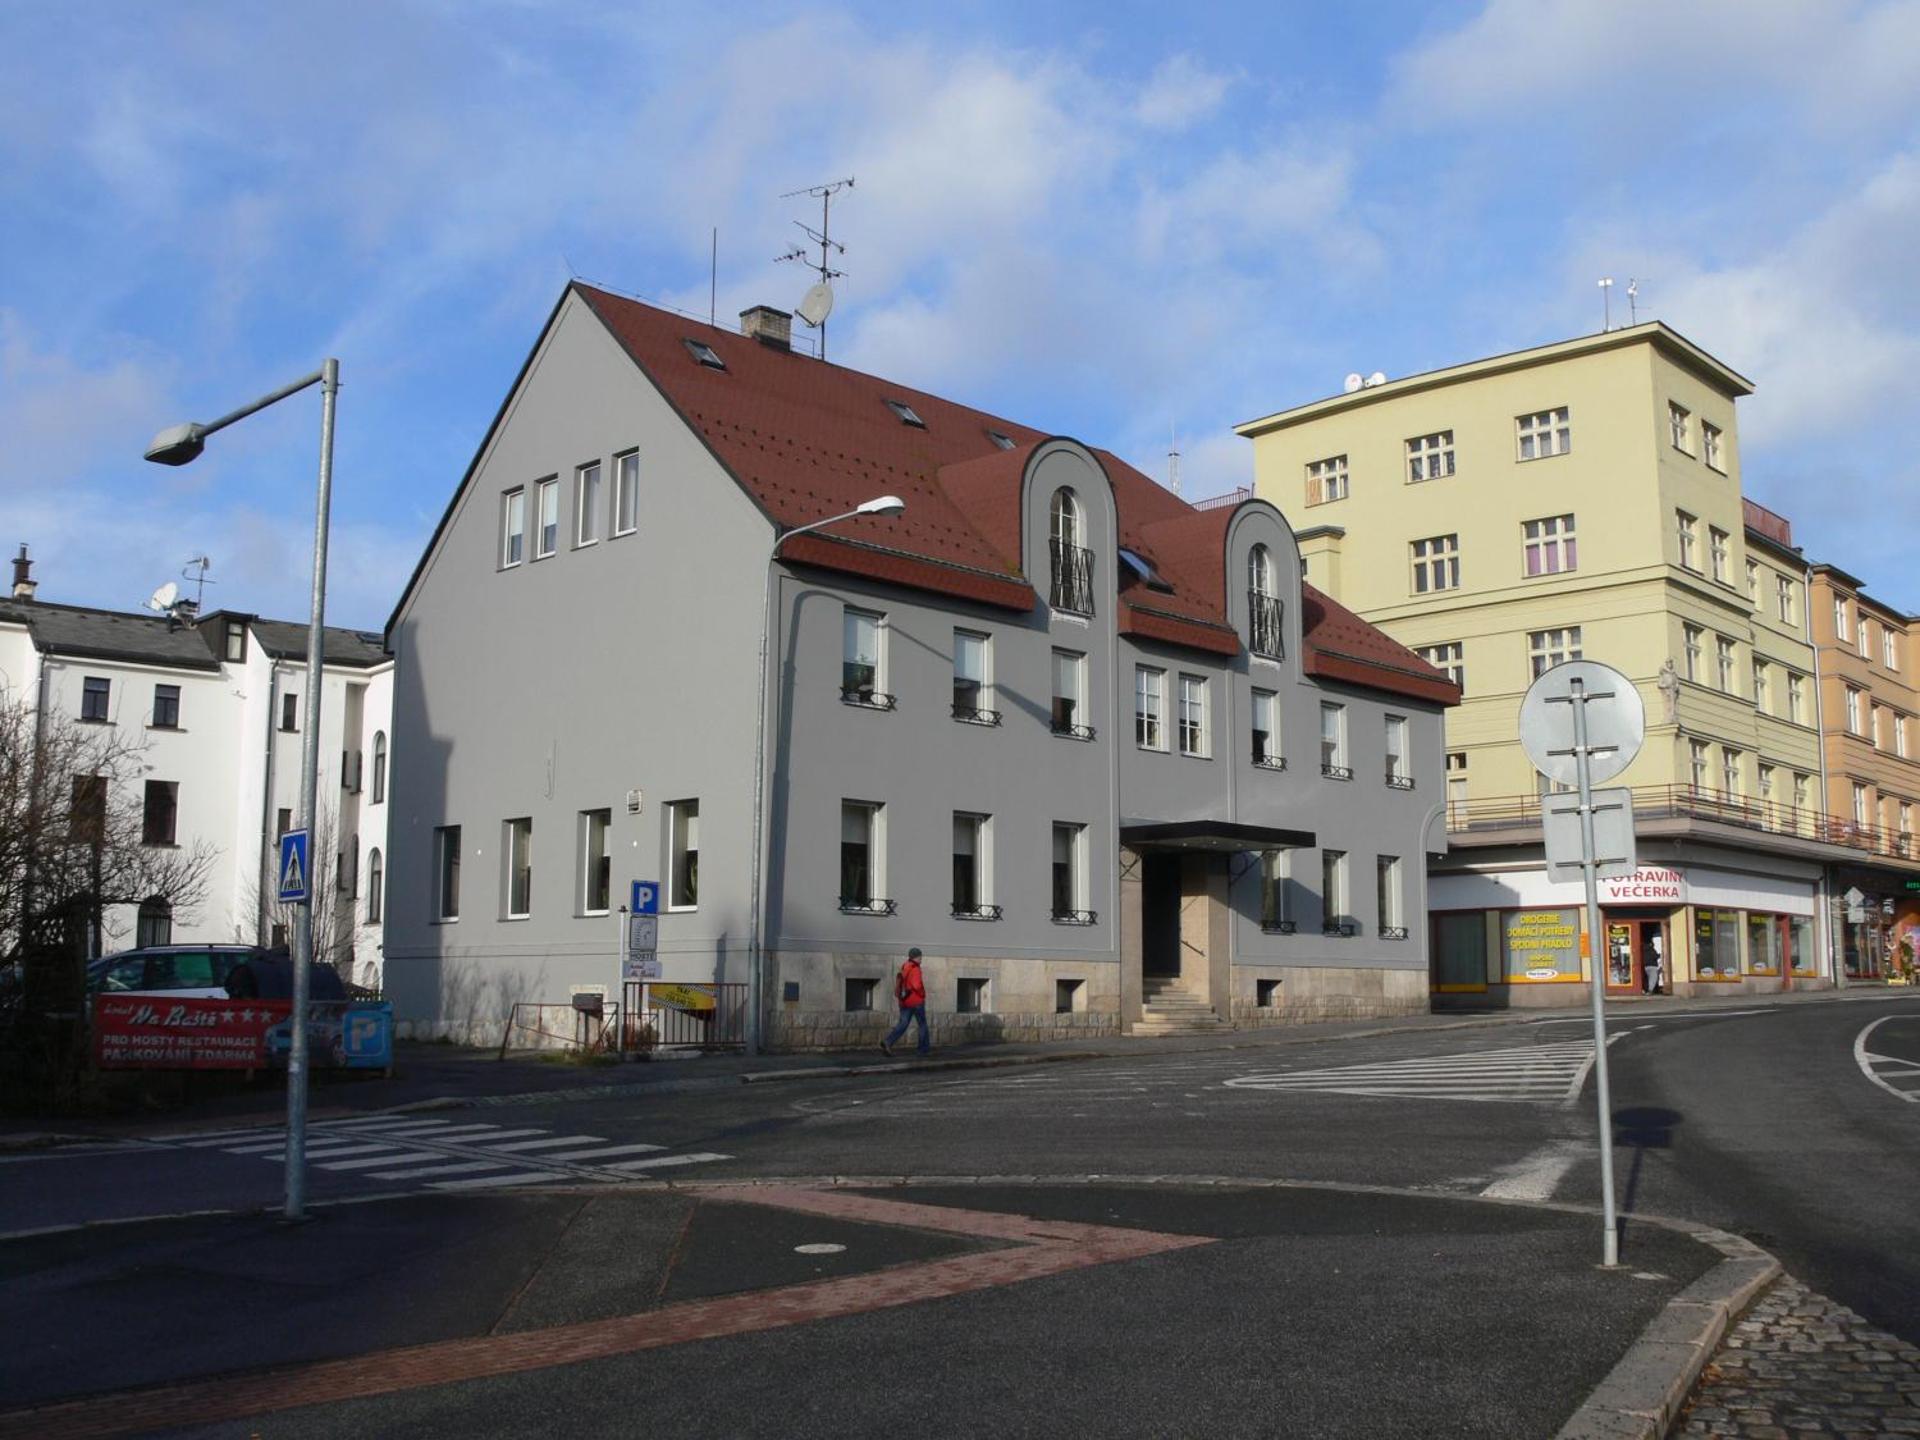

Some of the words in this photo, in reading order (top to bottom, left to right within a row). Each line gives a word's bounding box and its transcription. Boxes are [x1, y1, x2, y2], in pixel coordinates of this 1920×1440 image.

[1602, 871, 1684, 883] TRAVINY
[1610, 884, 1679, 898] VEČERKA
[638, 886, 653, 910] P
[102, 1034, 128, 1045] PRO
[131, 1035, 175, 1046] HOSTY
[178, 1036, 257, 1047] RESTAURACE
[352, 1017, 376, 1051] P
[194, 1049, 257, 1061] ZDARMA
